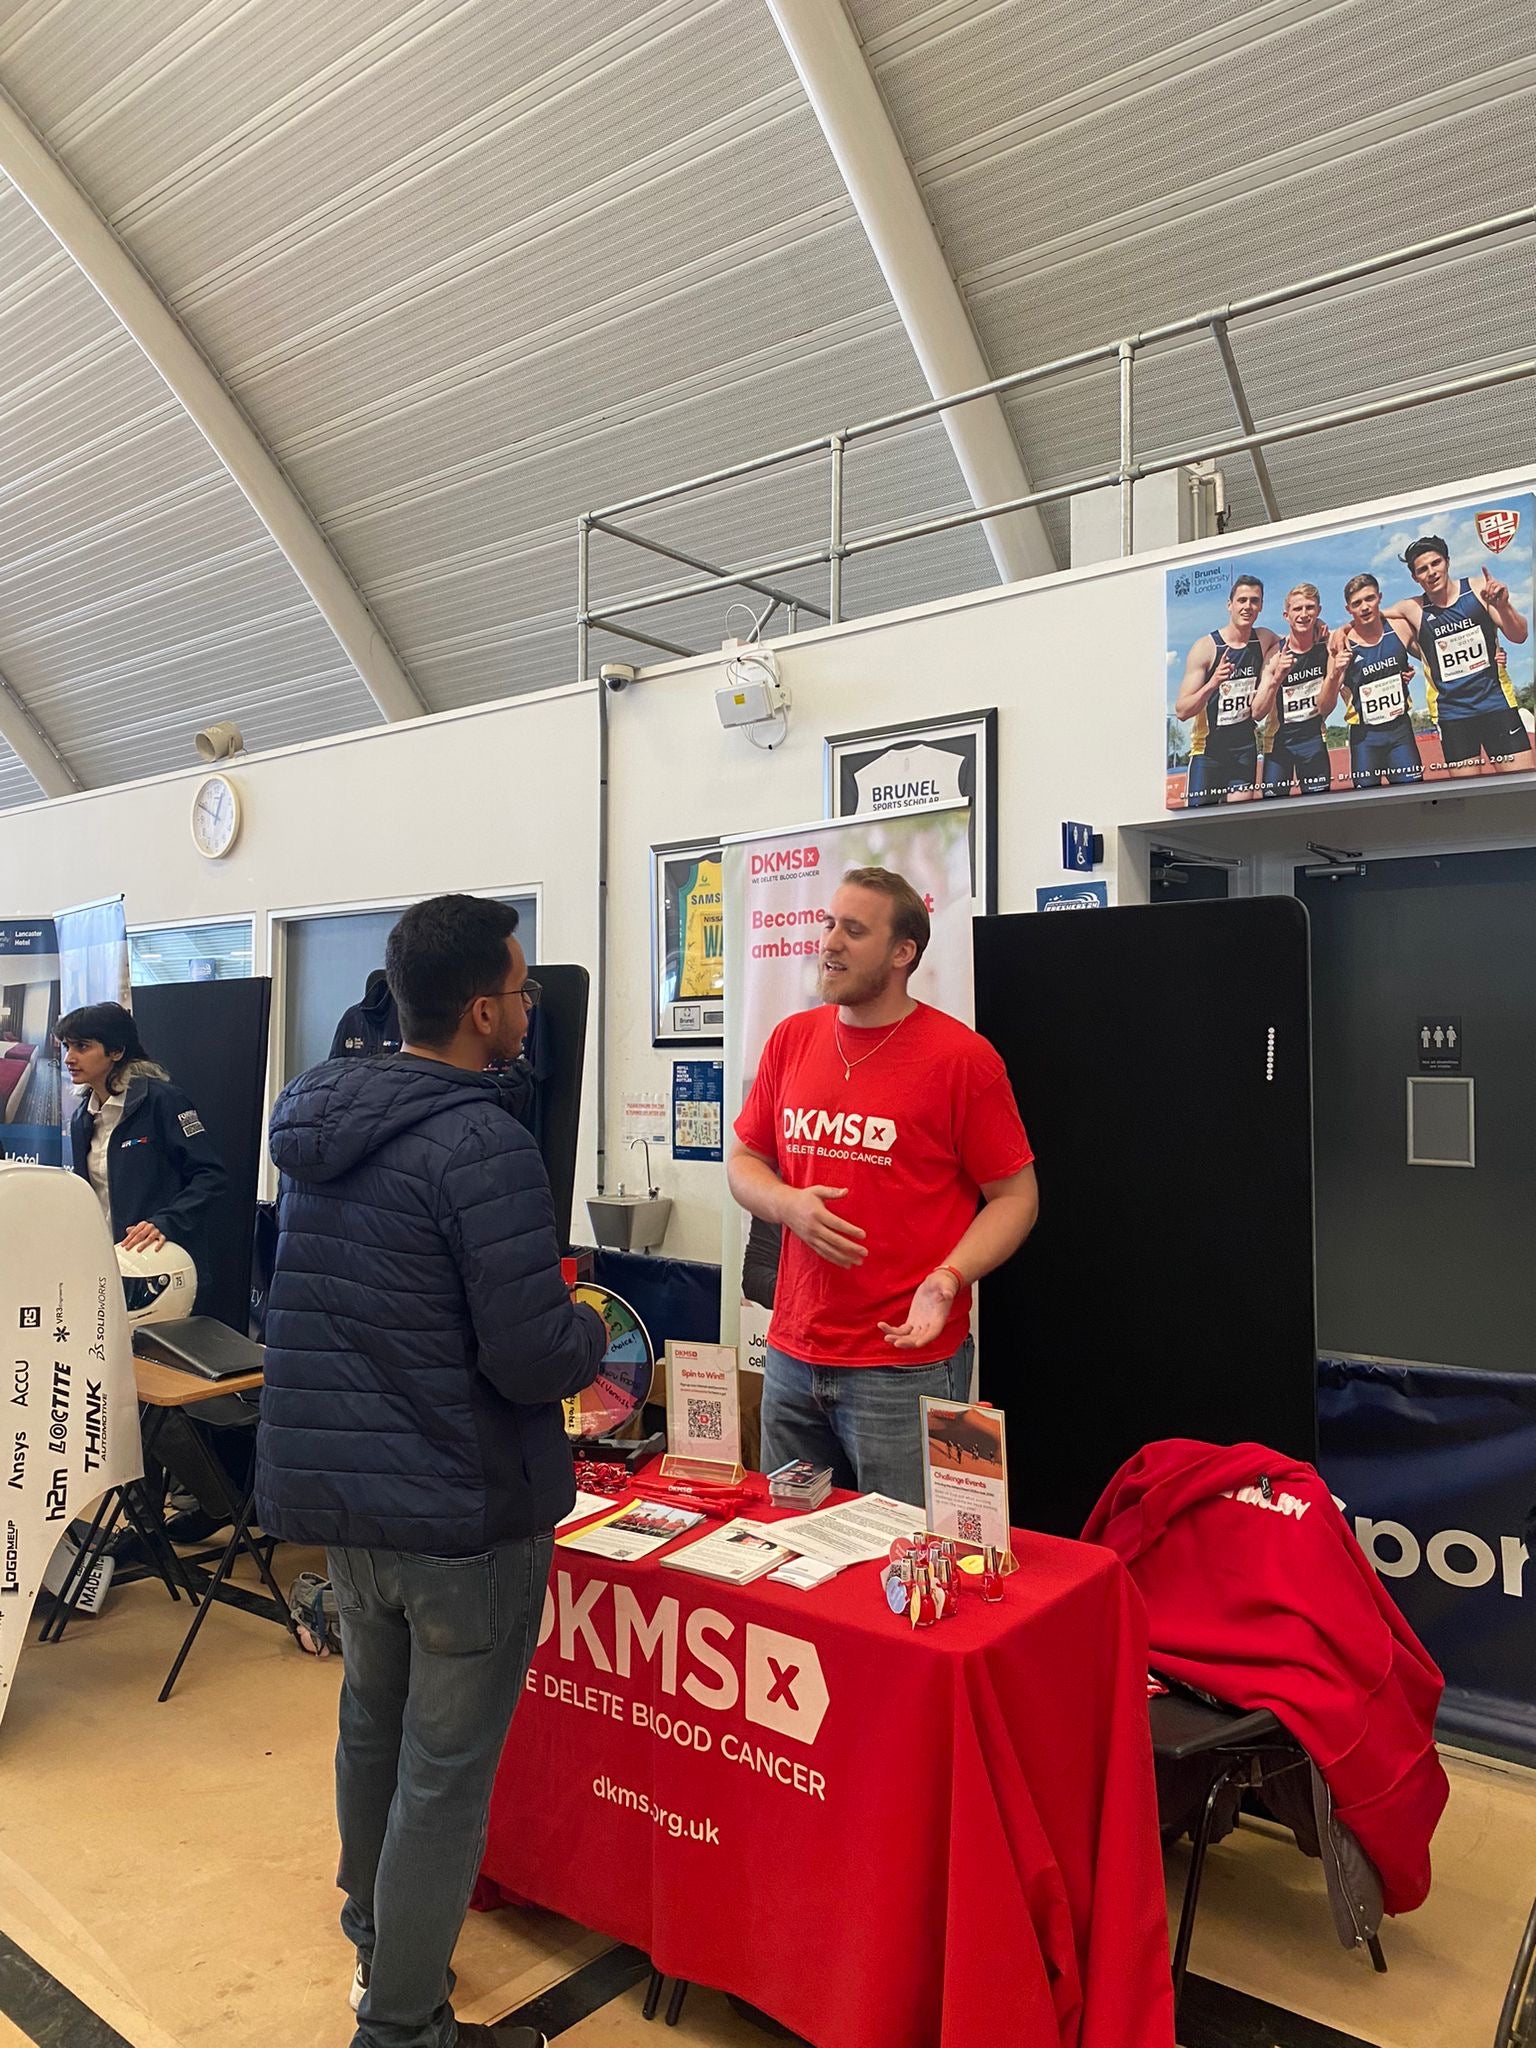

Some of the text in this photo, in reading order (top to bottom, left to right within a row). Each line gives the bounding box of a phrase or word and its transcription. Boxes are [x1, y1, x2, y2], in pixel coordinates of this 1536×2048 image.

[1194, 566, 1221, 579] Brunel
[1194, 574, 1230, 587] University
[1194, 583, 1221, 594] London
[1434, 618, 1475, 637] BRUNEL
[1362, 656, 1398, 676] BRUNEL
[1443, 643, 1483, 668] BRU
[1287, 666, 1323, 683] BRUNEL
[1366, 691, 1401, 714] BRU
[1180, 788, 1207, 798] Brunel
[1211, 786, 1235, 794] Men's
[1238, 783, 1274, 792] 4x400m
[1277, 779, 1301, 788] relay
[1304, 776, 1326, 784] team
[1338, 771, 1371, 781] British
[1374, 764, 1426, 777] University
[1430, 758, 1486, 770] Champions
[1490, 754, 1515, 763] 2015
[872, 780, 940, 802] BRUNEL
[873, 800, 902, 812] SPORTS
[751, 848, 803, 875] DKMS
[760, 874, 778, 883] DELETE
[779, 872, 798, 882] BLOOD
[798, 869, 820, 879] CANCER
[752, 907, 826, 929] Become
[783, 1107, 863, 1147] DKMS
[816, 1146, 849, 1160] BLOOD
[850, 1151, 893, 1166] CANCER
[24, 1308, 36, 1326] RS
[97, 1276, 107, 1340] SOLIDWORKS
[611, 1333, 637, 1353] choice!
[674, 1349, 692, 1357] DKMS
[10, 1360, 29, 1406] ACCU
[681, 1369, 697, 1380] Spin
[49, 1361, 71, 1454] LOCTITE
[85, 1378, 101, 1473] THINK
[8, 1431, 29, 1489] Ansys
[934, 1471, 987, 1489] Challenge Events
[46, 1468, 68, 1521] h2m
[1331, 1494, 1531, 1597] por
[80, 1571, 102, 1607] MADE
[544, 1674, 624, 1721] DELETE
[632, 1702, 712, 1752] BLOOD
[720, 1734, 826, 1801] CANCER
